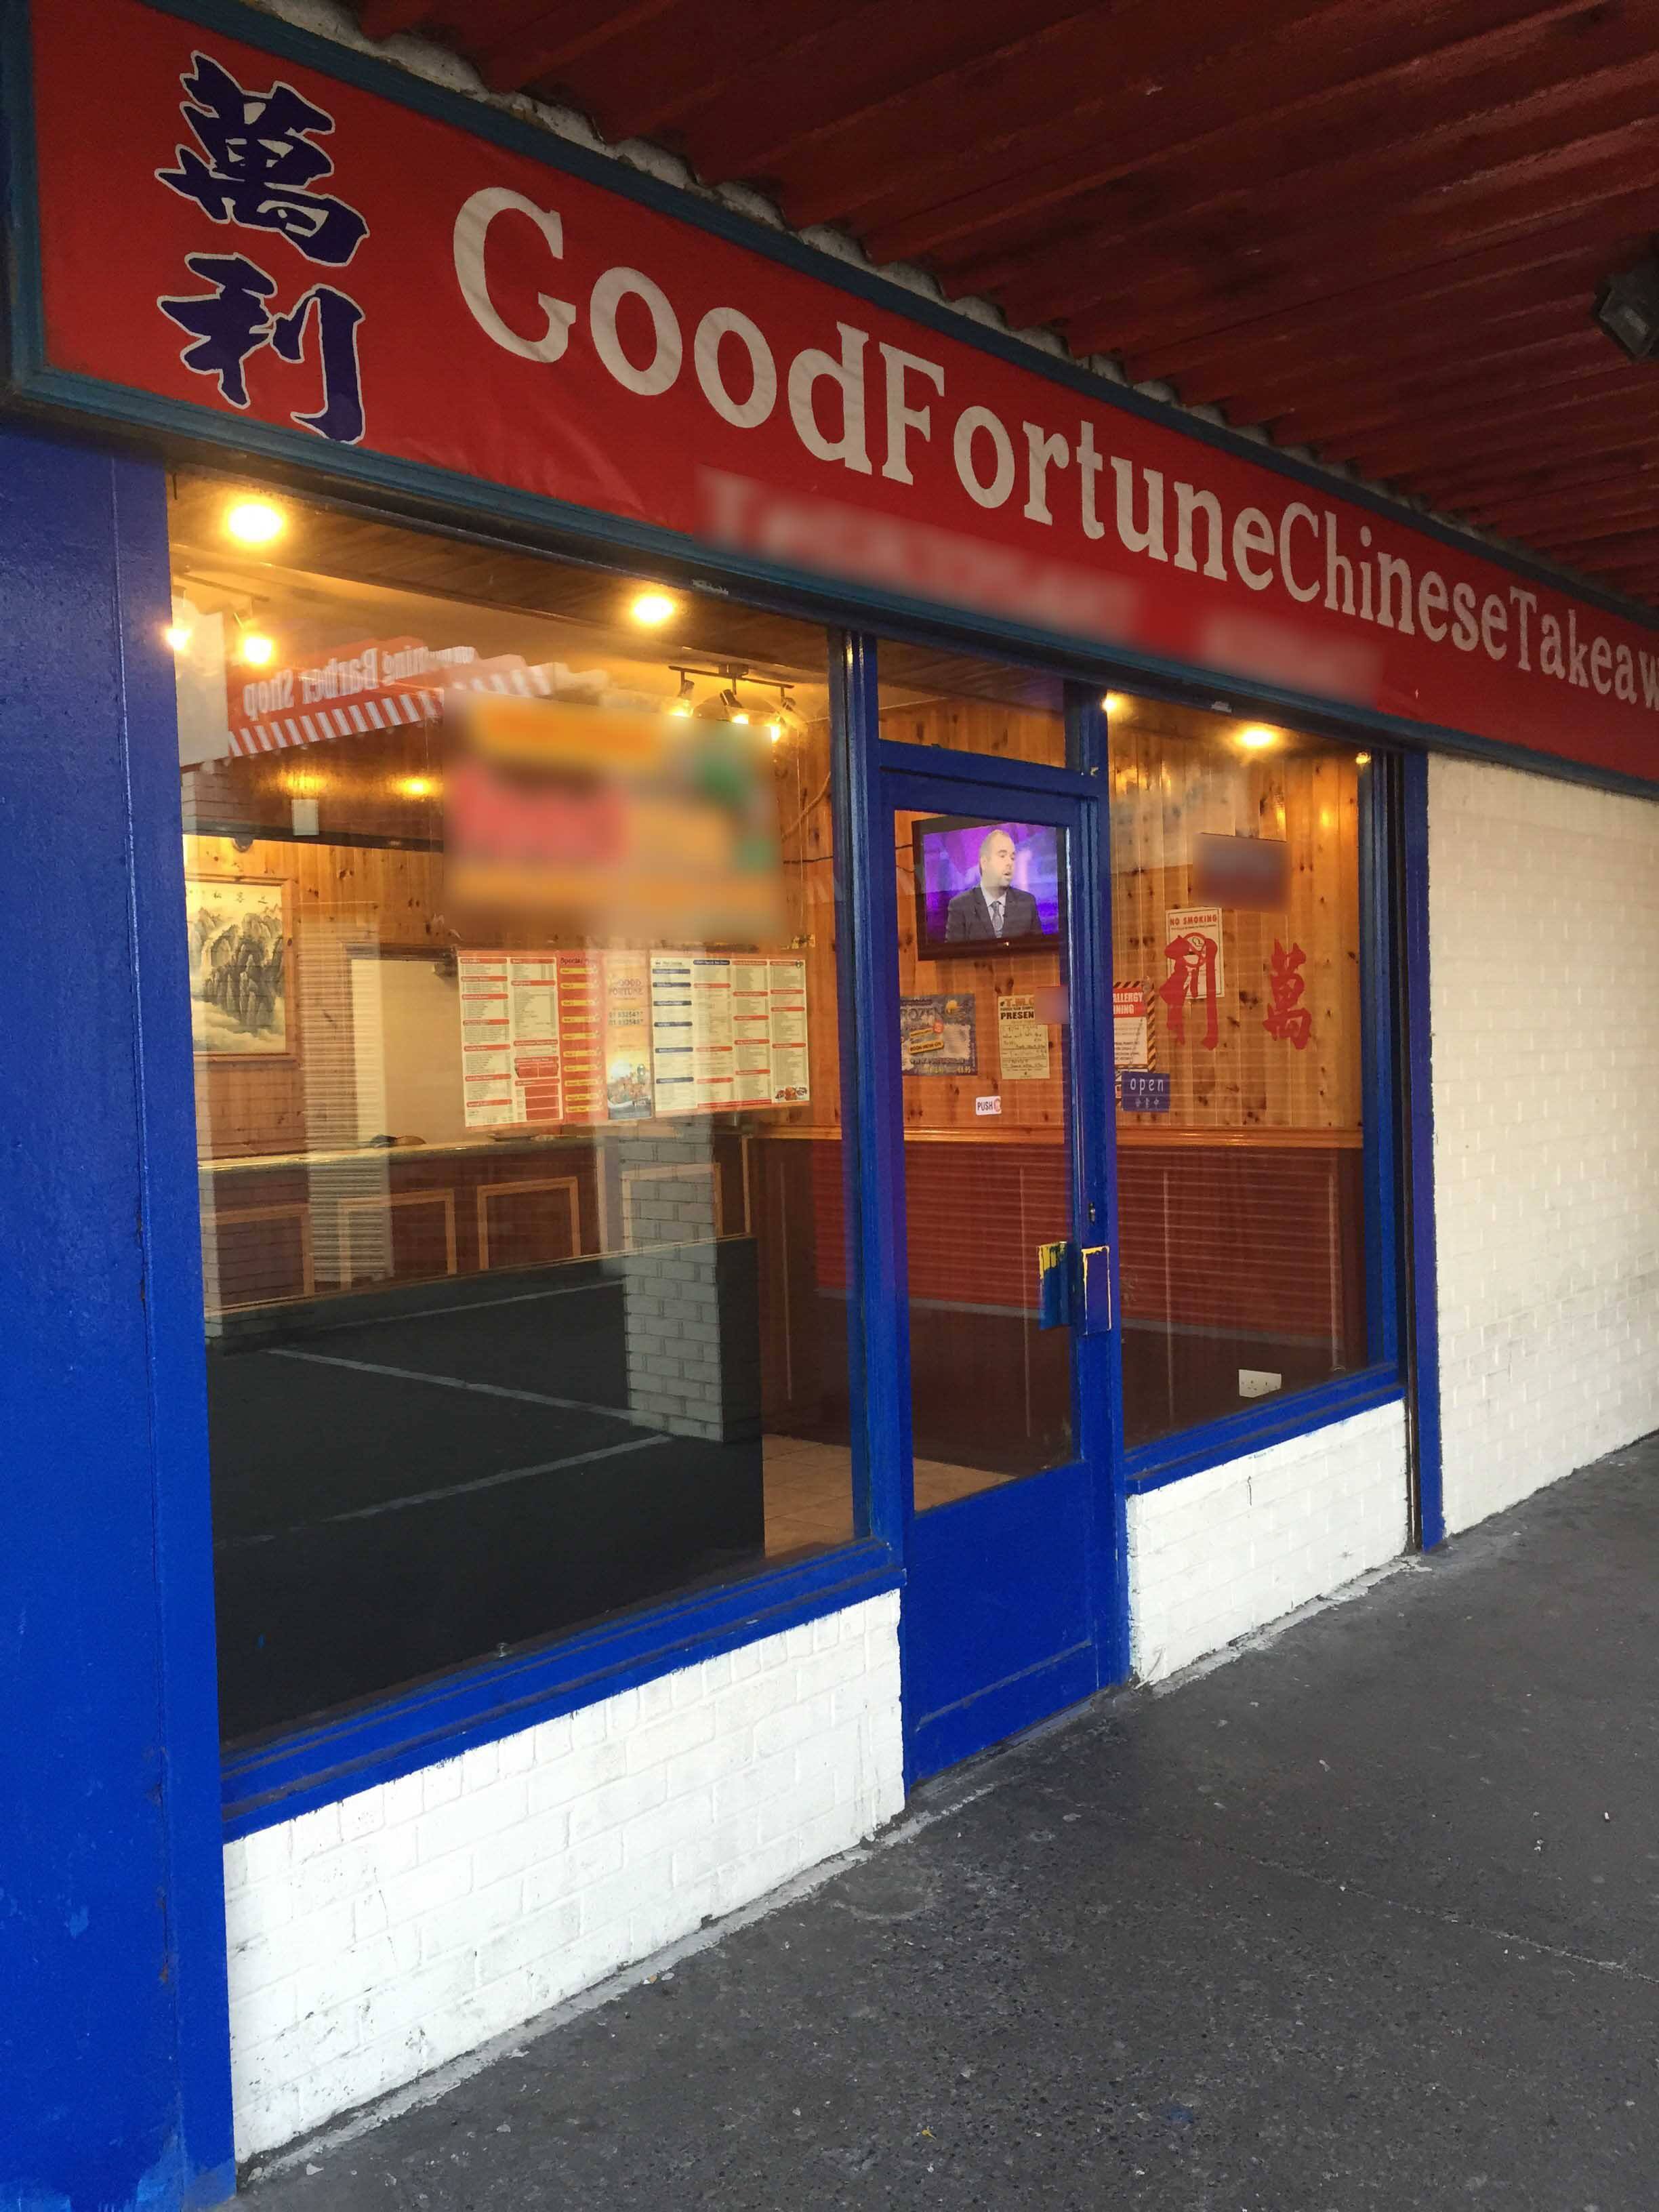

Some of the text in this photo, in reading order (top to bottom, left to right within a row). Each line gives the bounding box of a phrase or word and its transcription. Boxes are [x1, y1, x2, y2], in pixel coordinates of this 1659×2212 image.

[1170, 914, 1217, 926] NO SMOKING
[1113, 992, 1143, 1003] ALLERGY
[1130, 1078, 1164, 1096] open
[977, 1101, 993, 1111] PUSH
